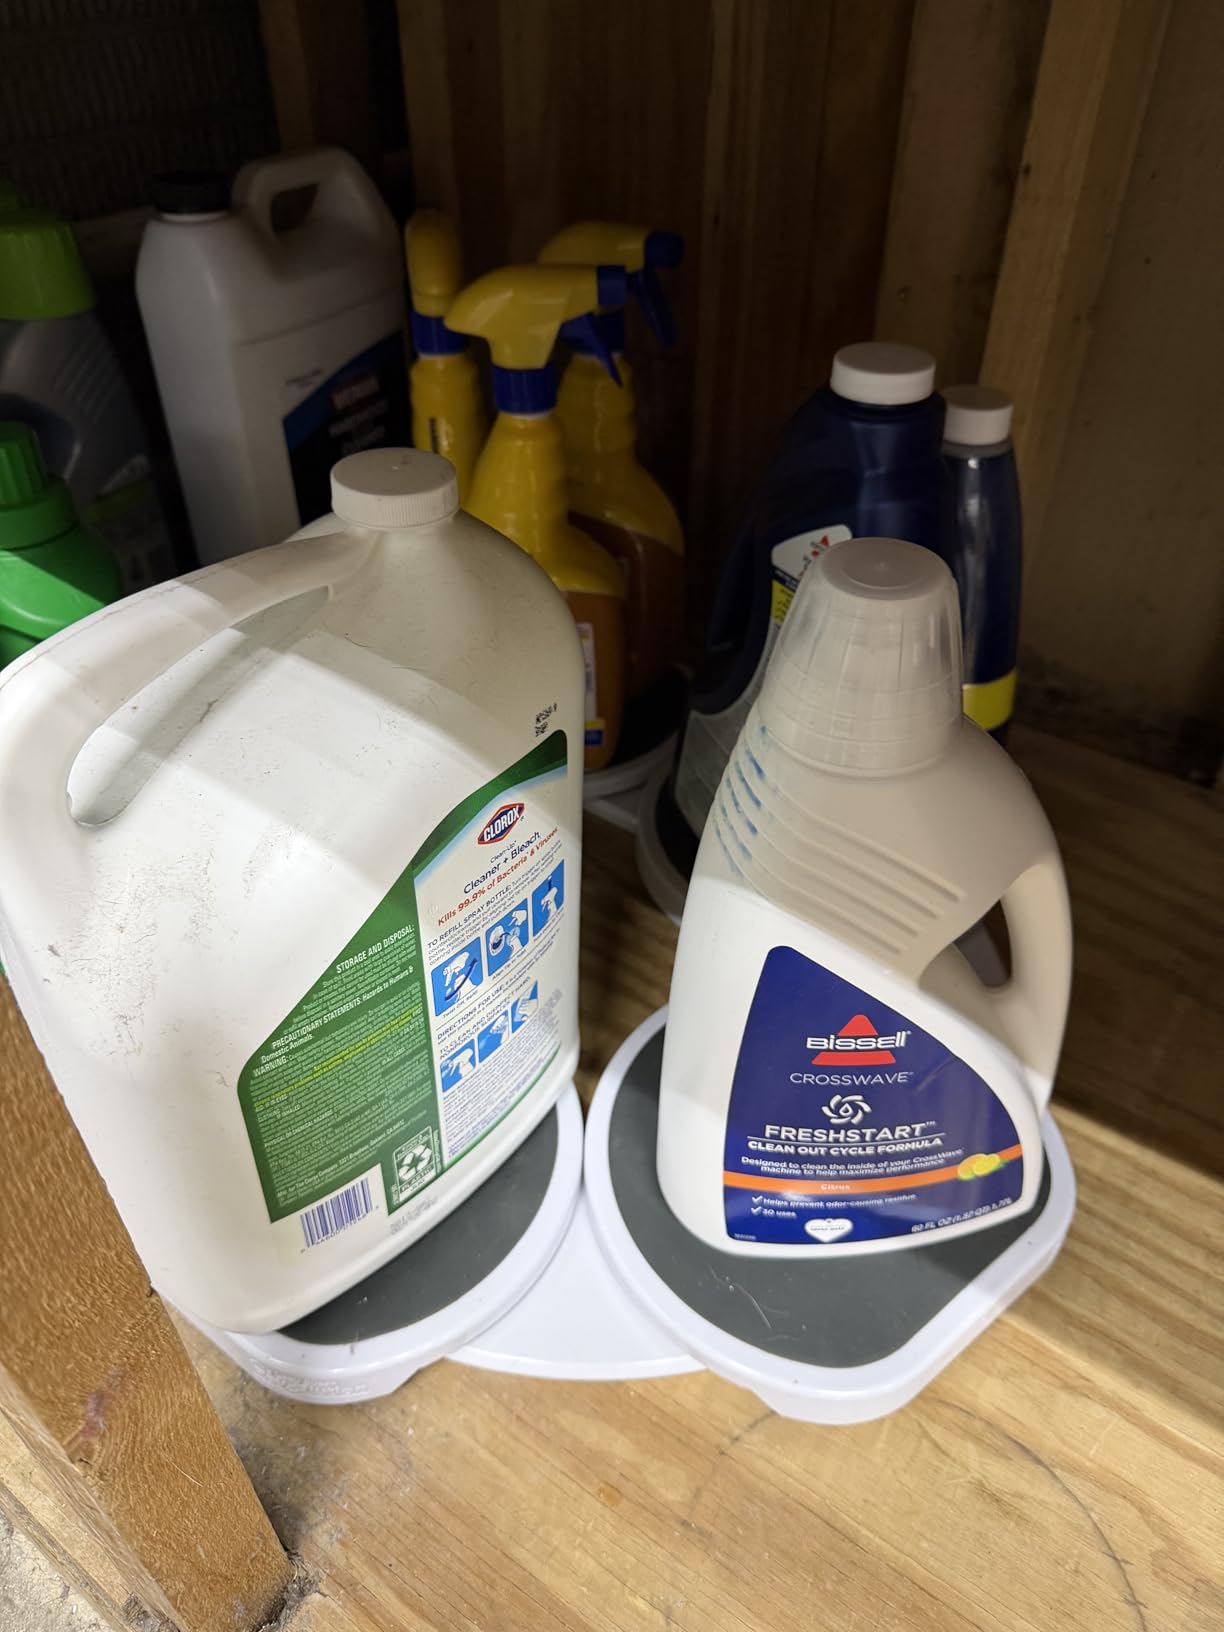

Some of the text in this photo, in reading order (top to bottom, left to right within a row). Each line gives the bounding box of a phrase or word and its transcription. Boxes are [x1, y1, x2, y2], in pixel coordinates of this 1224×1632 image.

[484, 806, 520, 842] CLOROX
[464, 864, 500, 894] Cleaner
[511, 832, 540, 860] Bleach
[438, 910, 456, 926] Kills
[458, 886, 486, 912] 99.9%
[487, 879, 496, 890] of
[497, 855, 528, 883] Bacteria
[427, 939, 438, 948] TO
[440, 921, 462, 940] REFILL
[464, 905, 484, 924] SPRAY
[486, 886, 511, 906] BOTTLE:
[336, 924, 415, 974] STORAGE AND DISPOSAL:
[272, 1018, 323, 1049] PRECAUTIONARY
[323, 998, 362, 1024] STATEMENTS:
[362, 986, 383, 1002] Hazards
[389, 970, 408, 985] Humans
[437, 983, 504, 1039] DIRECTIONS FOR USE:
[253, 1054, 289, 1077] WARNING:
[261, 1045, 290, 1064] Domestic
[741, 1156, 786, 1168] Designed
[848, 1162, 876, 1170] inside
[878, 1160, 888, 1168] of
[890, 1158, 911, 1168] your
[748, 1138, 942, 1155] CLEAN OUT CYCLE FORMULA
[760, 1166, 801, 1175] machine
[839, 1168, 885, 1176] maximize
[886, 1159, 945, 1173] performance
[938, 1218, 952, 1226] OZ
